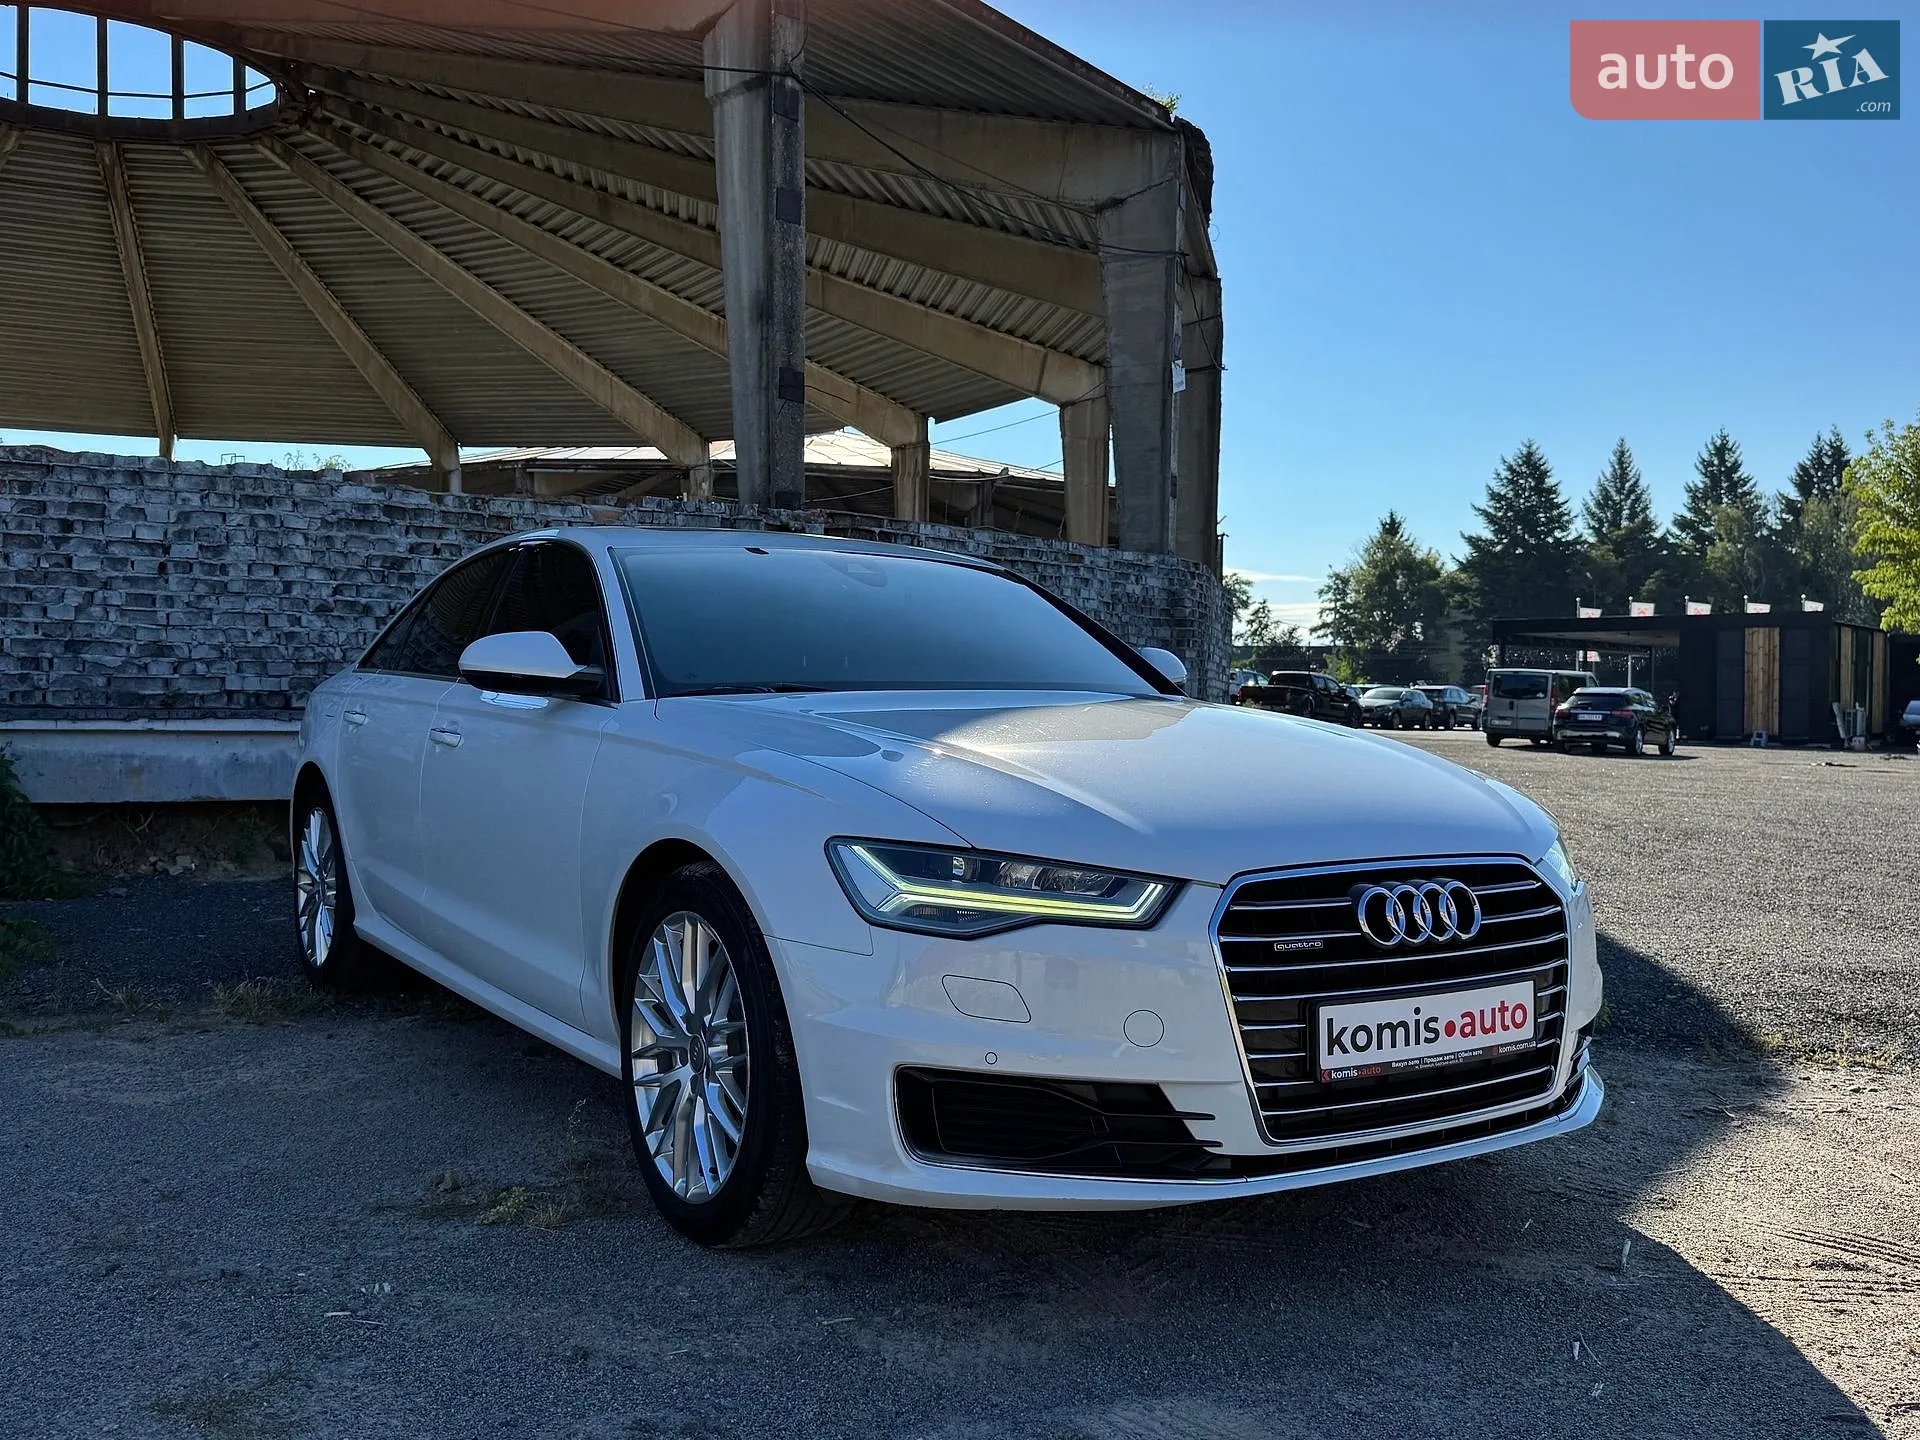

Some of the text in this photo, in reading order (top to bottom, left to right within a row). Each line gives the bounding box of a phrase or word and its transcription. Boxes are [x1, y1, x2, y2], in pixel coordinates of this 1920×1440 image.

[1276, 941, 1322, 951] quattro
[1498, 1040, 1536, 1054] komis.com.ua
[1423, 1056, 1443, 1064] Продаж
